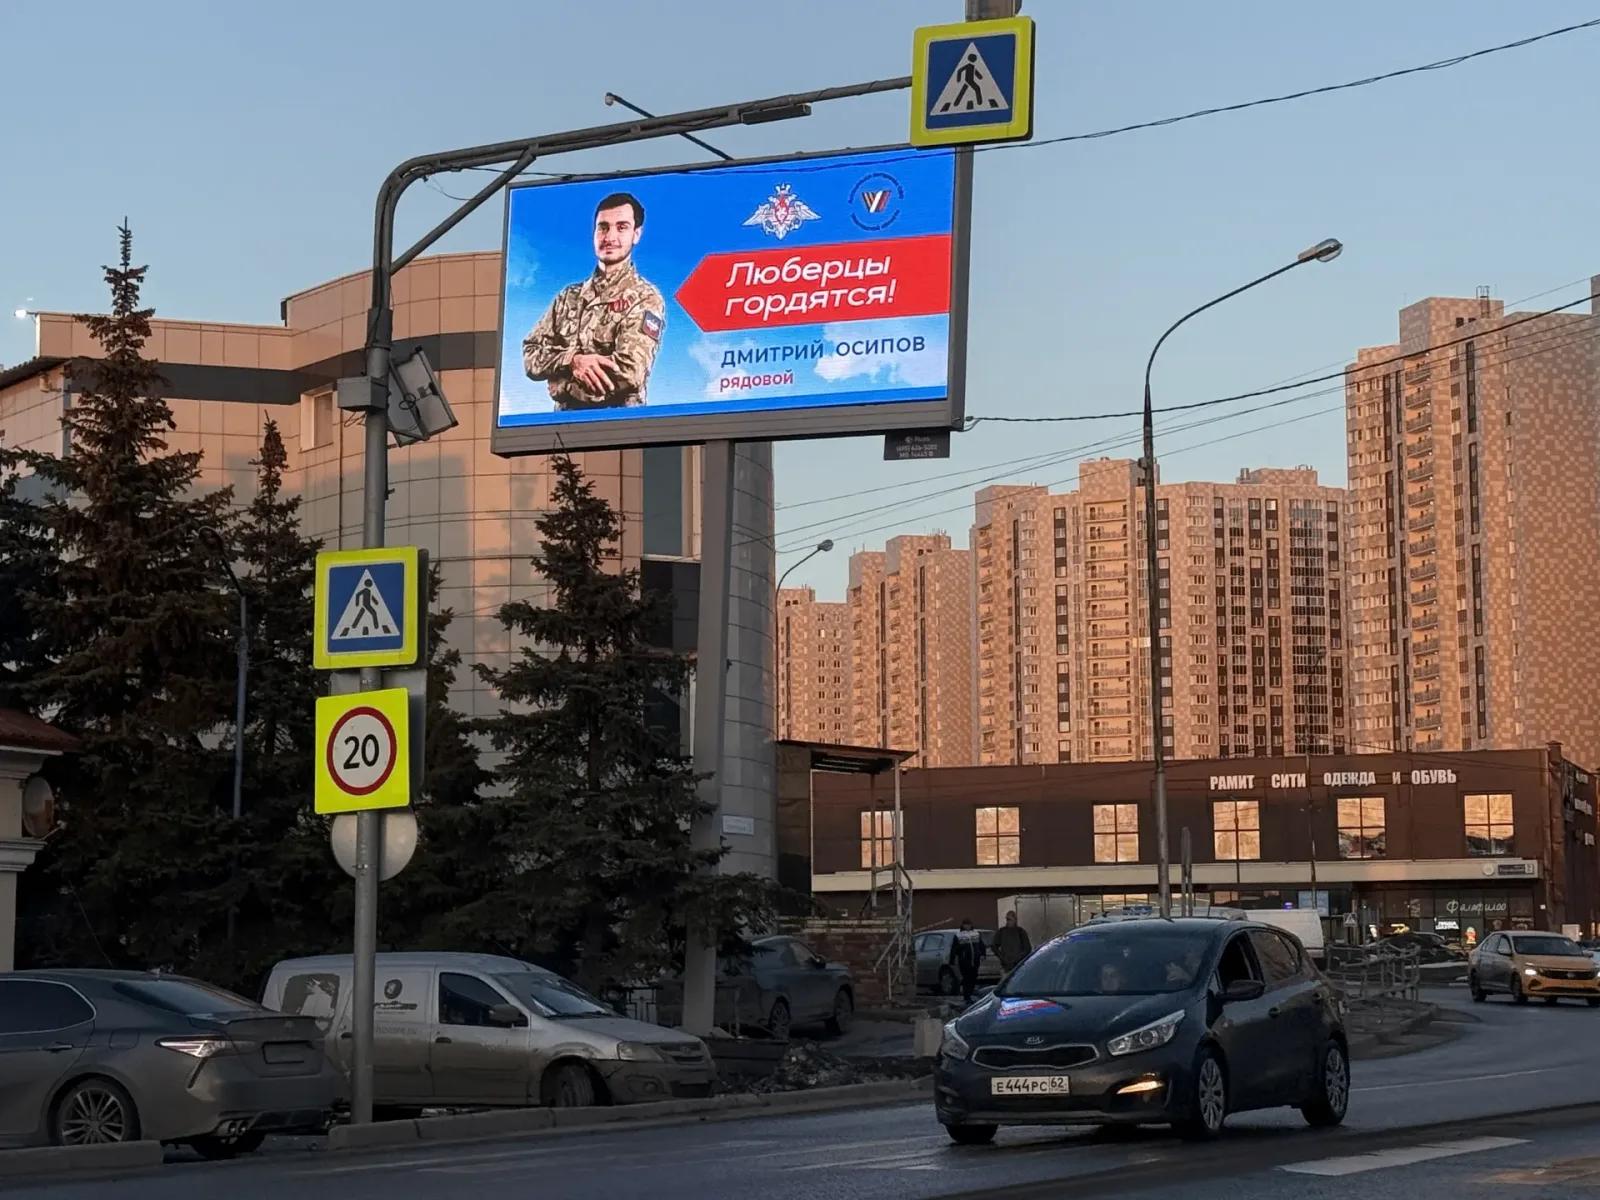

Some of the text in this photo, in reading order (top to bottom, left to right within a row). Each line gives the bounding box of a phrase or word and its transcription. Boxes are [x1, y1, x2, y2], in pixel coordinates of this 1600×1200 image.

[725, 256, 891, 288] Люберцы
[725, 278, 897, 321] гордятся!
[721, 336, 925, 368] ДМИТРИЙ ОСИПОВ
[720, 369, 794, 392] рядовой
[343, 733, 380, 770] 20
[1210, 769, 1457, 790] РАМИТ СИТИ ОДЕЖДА И ОБУВЬ
[996, 1079, 1047, 1092] Е444РС
[1051, 1077, 1064, 1088] 62
